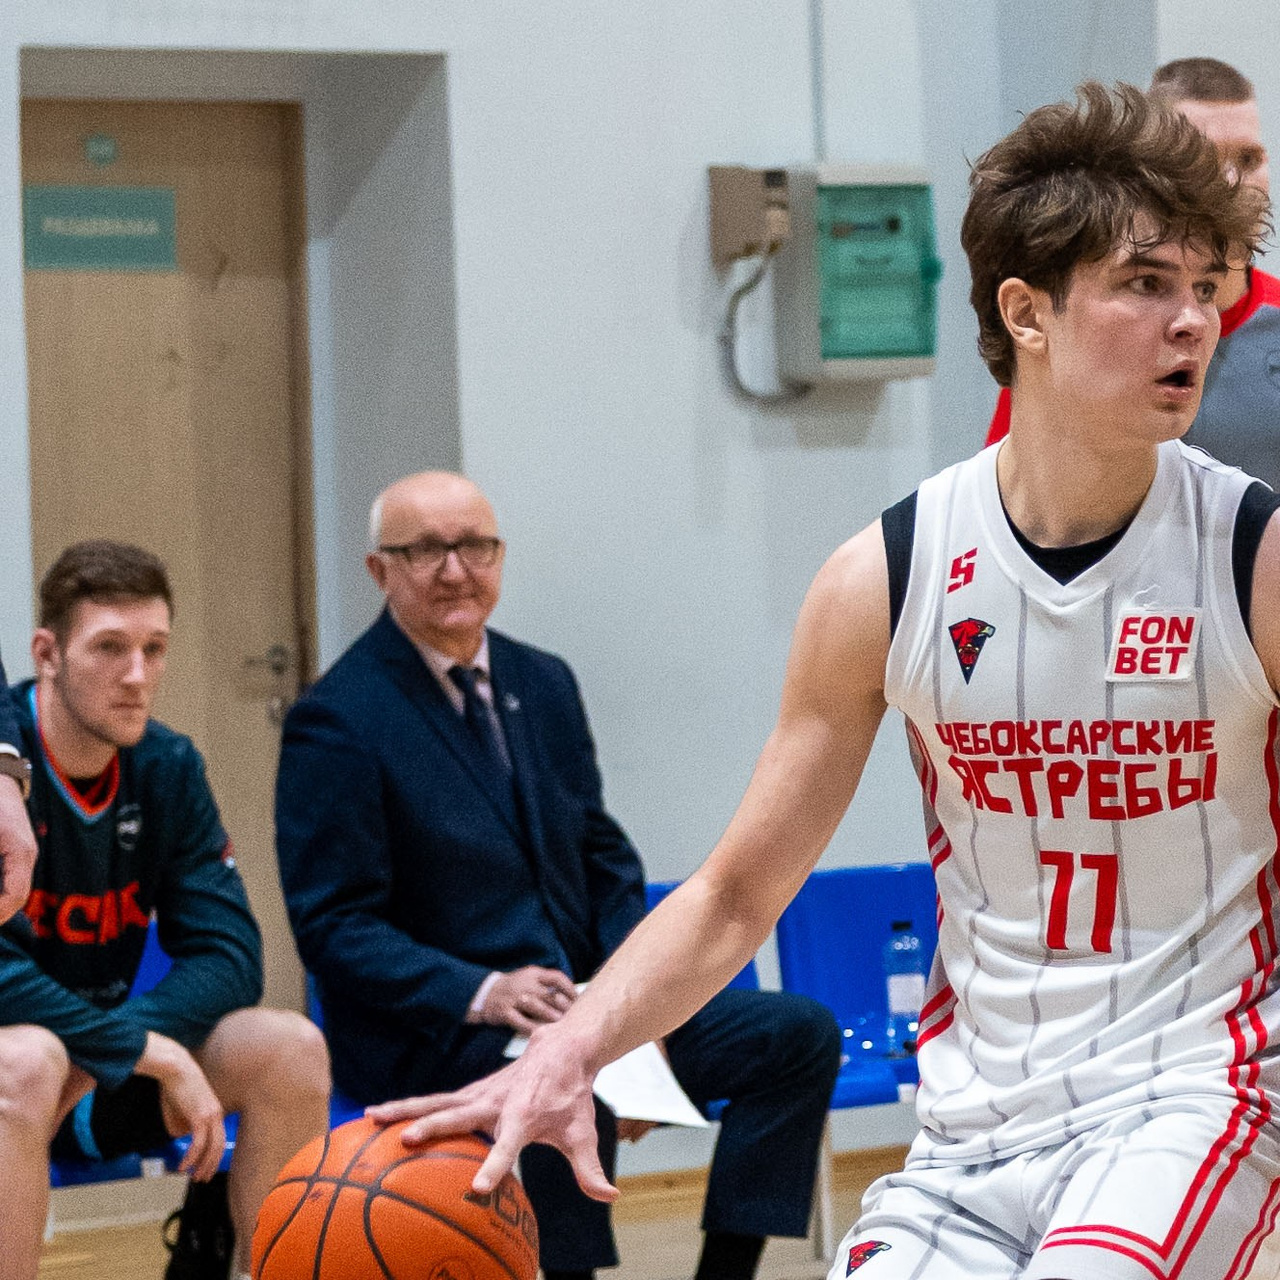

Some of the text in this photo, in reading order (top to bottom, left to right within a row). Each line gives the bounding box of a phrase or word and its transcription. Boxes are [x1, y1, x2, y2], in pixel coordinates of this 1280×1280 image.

[1119, 615, 1194, 644] FON
[1114, 646, 1189, 675] BET
[934, 720, 1216, 756] ЧЕБОКСАРСКИЕ
[948, 753, 1218, 820] ЯСТРЕБЫ
